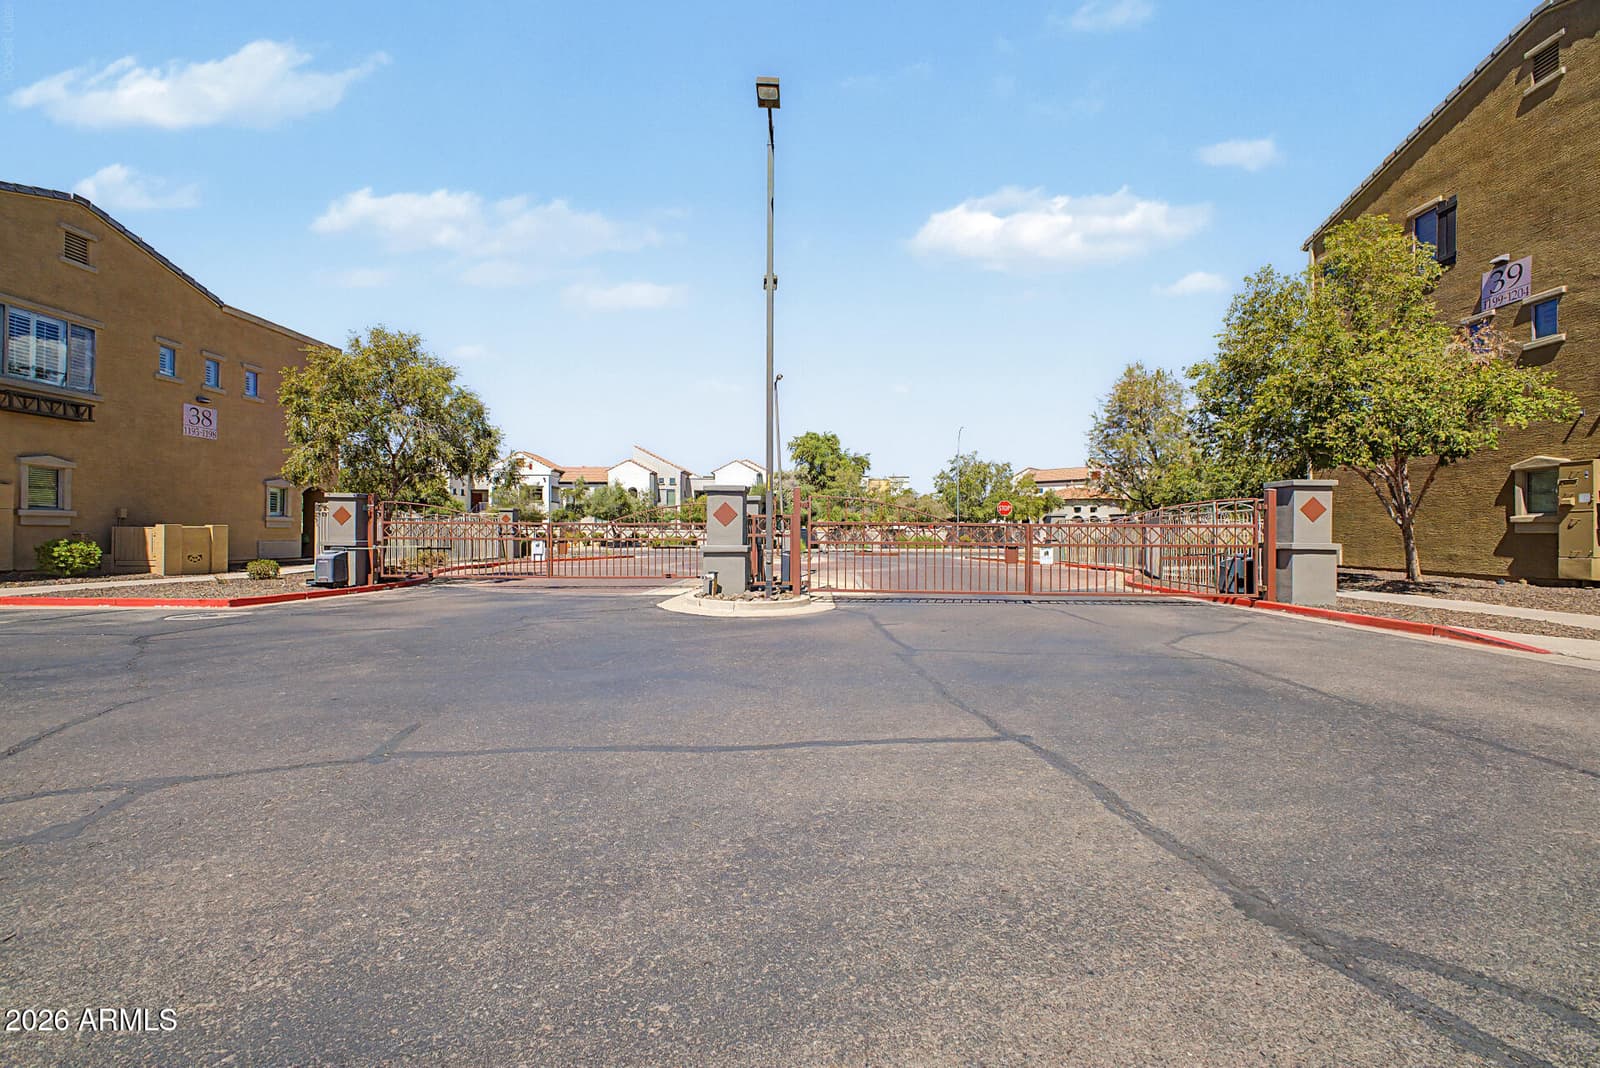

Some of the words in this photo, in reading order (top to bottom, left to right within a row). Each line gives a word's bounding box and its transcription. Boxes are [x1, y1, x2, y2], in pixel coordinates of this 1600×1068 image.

[1490, 263, 1522, 294] 39
[1484, 286, 1529, 309] 1199-1204
[189, 407, 212, 427] 38
